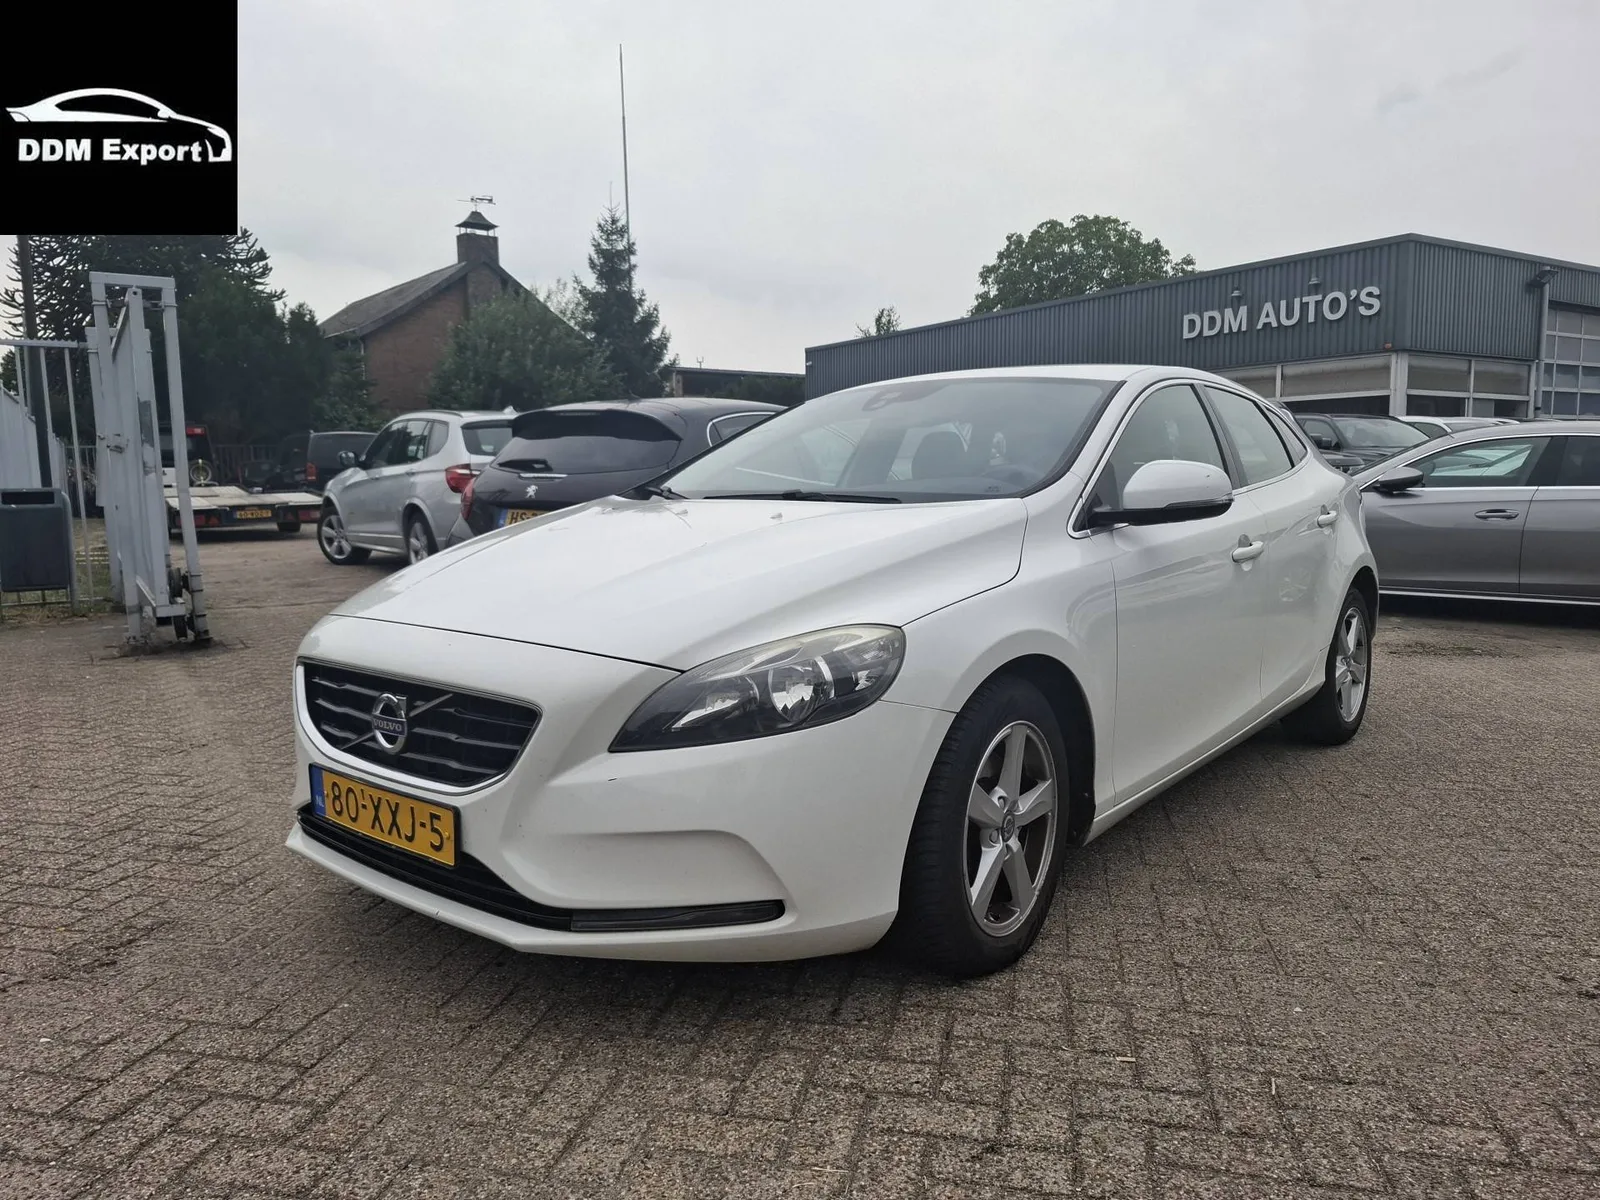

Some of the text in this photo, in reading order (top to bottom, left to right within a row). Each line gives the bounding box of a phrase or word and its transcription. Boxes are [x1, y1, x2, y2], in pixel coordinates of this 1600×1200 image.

[1182, 285, 1381, 340] DDM AUTO'S
[373, 718, 402, 732] VOLVO
